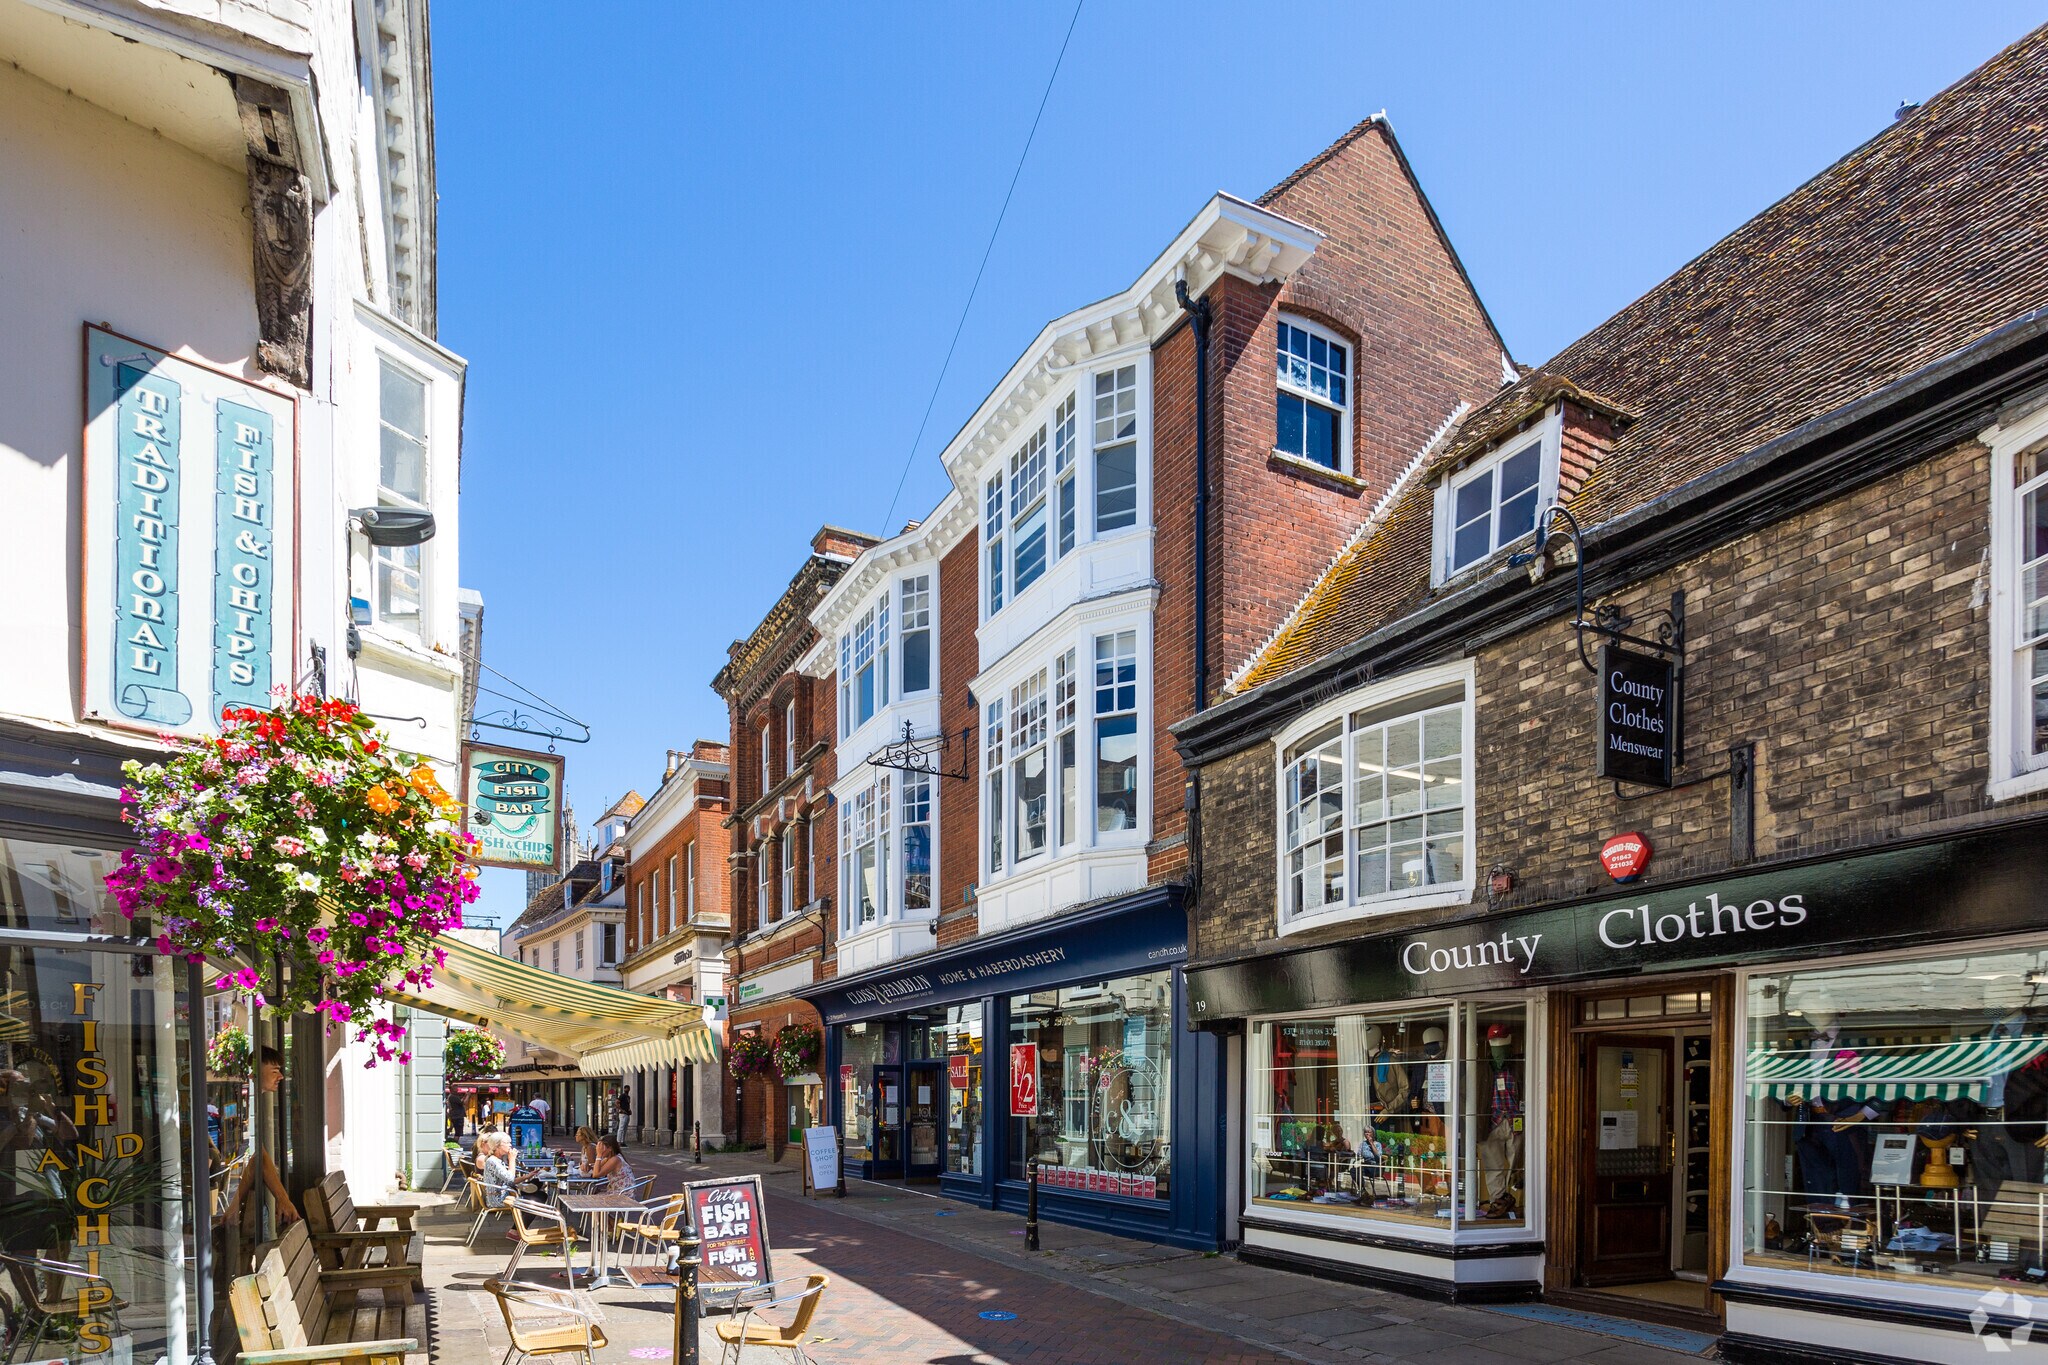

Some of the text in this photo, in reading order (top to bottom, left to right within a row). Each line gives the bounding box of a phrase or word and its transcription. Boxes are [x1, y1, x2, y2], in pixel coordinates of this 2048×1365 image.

[127, 385, 174, 677] TRADITIONAL
[226, 421, 268, 687] FISH & CHIPS
[1610, 670, 1664, 707] County
[1609, 733, 1664, 760] Menswear
[493, 762, 538, 776] CITY
[493, 785, 538, 796] FISH
[495, 802, 534, 814] BAR
[470, 826, 494, 837] BEST
[505, 840, 513, 850] &
[514, 840, 553, 854] CHIPS
[509, 849, 551, 862] IN TOWN
[1609, 860, 1634, 870] 221035
[1611, 853, 1632, 862] 01843
[1402, 892, 1807, 976] County Clothes
[1148, 944, 1188, 959] candh.co.uk
[939, 947, 1067, 985] HOME & HABERDASHERY
[846, 974, 932, 1005] CLOSS & HAMBLIN
[1196, 1000, 1206, 1012] 19
[68, 981, 113, 1127] FISH
[951, 1066, 968, 1078] SALE
[35, 1132, 145, 1173] AND
[810, 1147, 836, 1156] COFFEE
[814, 1154, 834, 1162] SHOP
[707, 1188, 741, 1205] City
[701, 1202, 750, 1225] FISH
[703, 1222, 748, 1240] BAR
[707, 1246, 756, 1266] FISH AND
[75, 1177, 115, 1355] CHIPS
